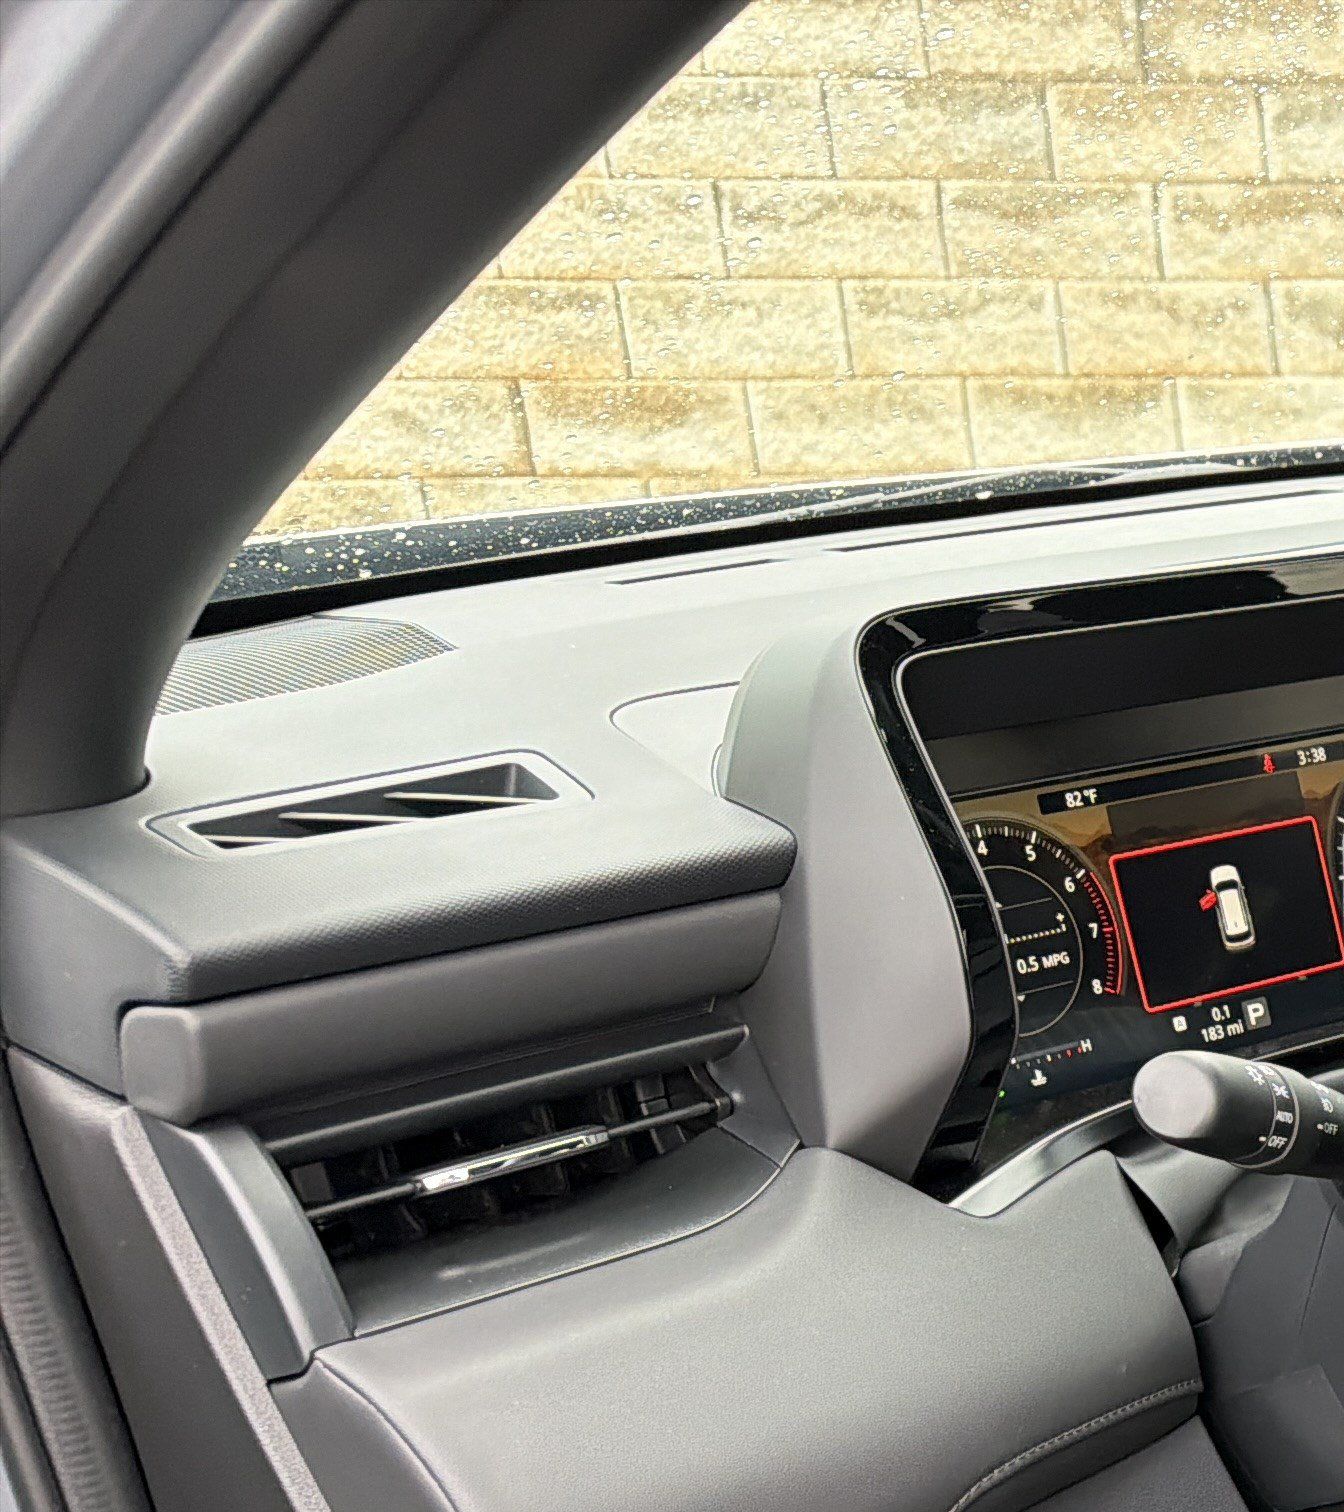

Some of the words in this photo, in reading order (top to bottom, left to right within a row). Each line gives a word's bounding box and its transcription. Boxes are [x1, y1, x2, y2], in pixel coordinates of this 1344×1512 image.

[1296, 747, 1327, 766] 3:38
[1064, 788, 1098, 808] 82°F
[977, 840, 989, 856] 4
[1025, 845, 1037, 862] 5
[1064, 877, 1076, 893] 6
[1087, 922, 1098, 938] 7
[1016, 955, 1040, 975] 0.5
[1042, 952, 1070, 969] MPG
[1091, 979, 1103, 995] 8
[1211, 1004, 1231, 1022] 0.1
[1246, 1002, 1265, 1026] P
[1201, 1024, 1225, 1043] 183
[1226, 1019, 1245, 1037] mi
[1080, 1038, 1093, 1053] H
[1323, 1122, 1339, 1136] OFF
[1267, 1135, 1289, 1149] OFF
